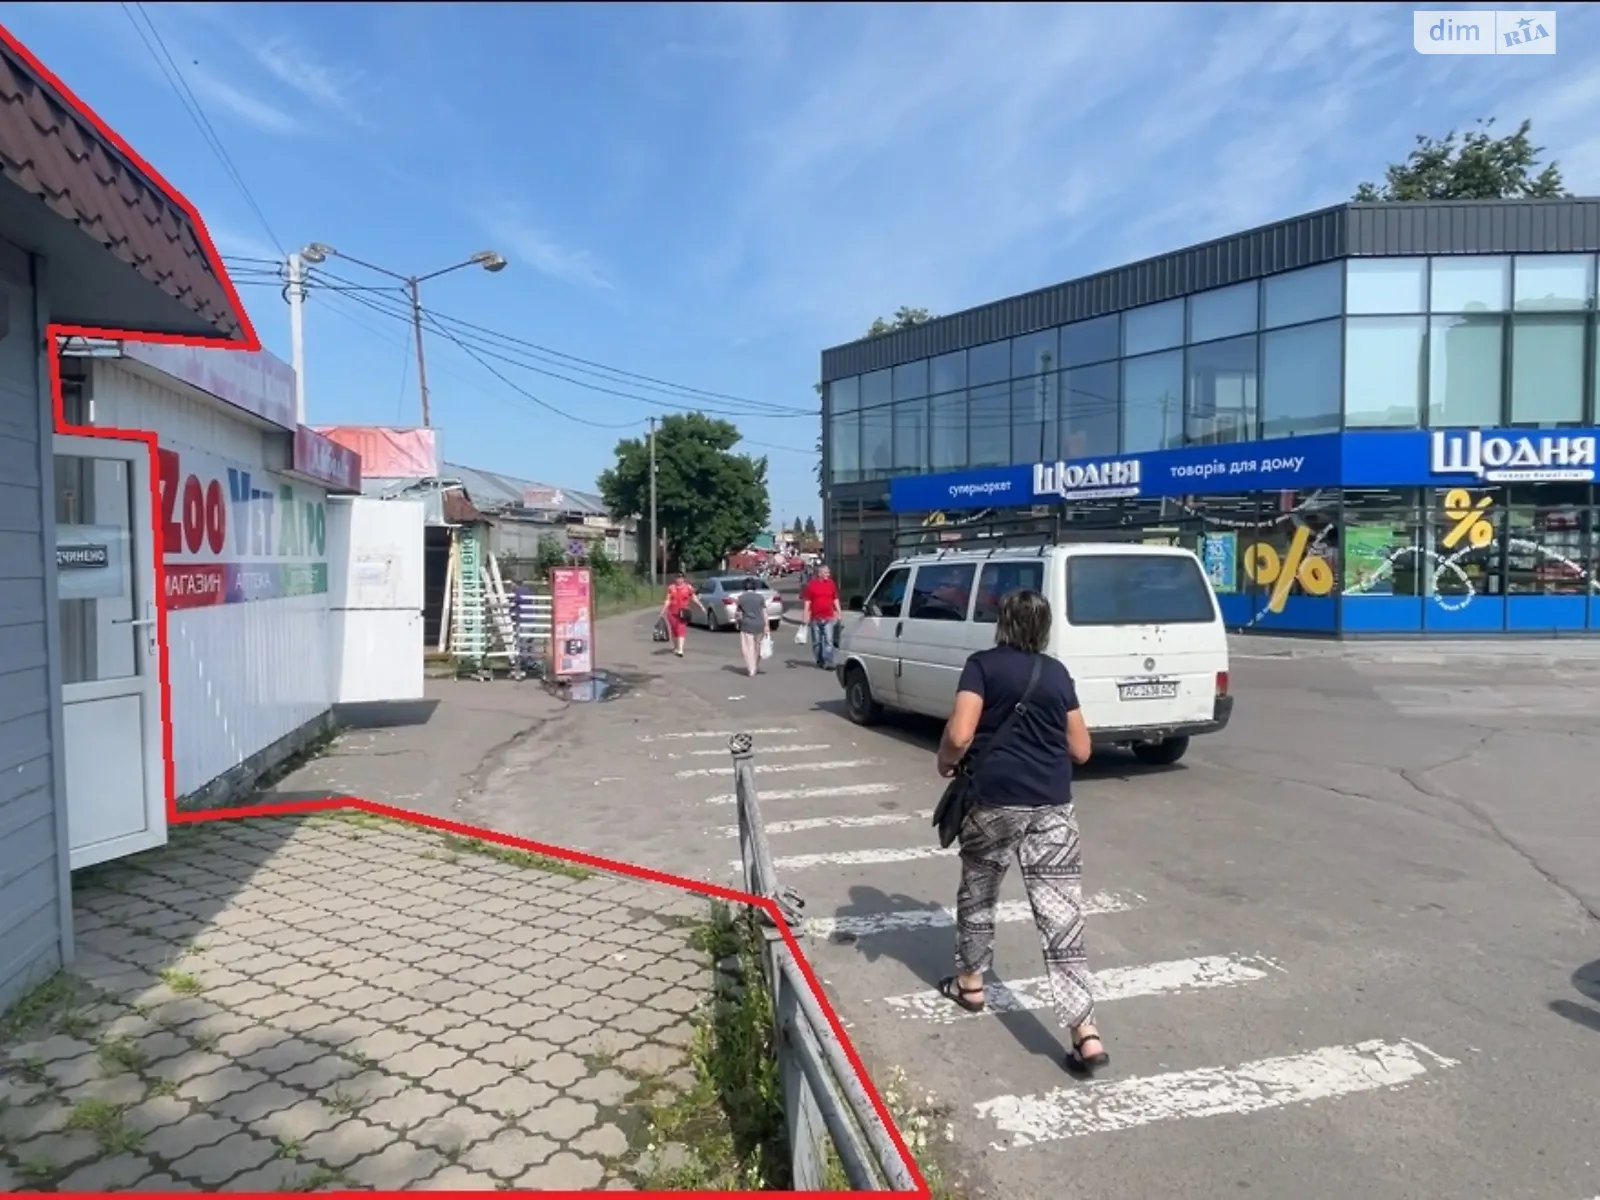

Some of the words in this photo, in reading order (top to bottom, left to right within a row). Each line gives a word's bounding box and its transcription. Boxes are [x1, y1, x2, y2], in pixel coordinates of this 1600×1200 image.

[1170, 458, 1226, 480] товарів
[1229, 459, 1258, 475] для
[1260, 456, 1305, 473] дому
[949, 481, 1012, 498] супермаркет
